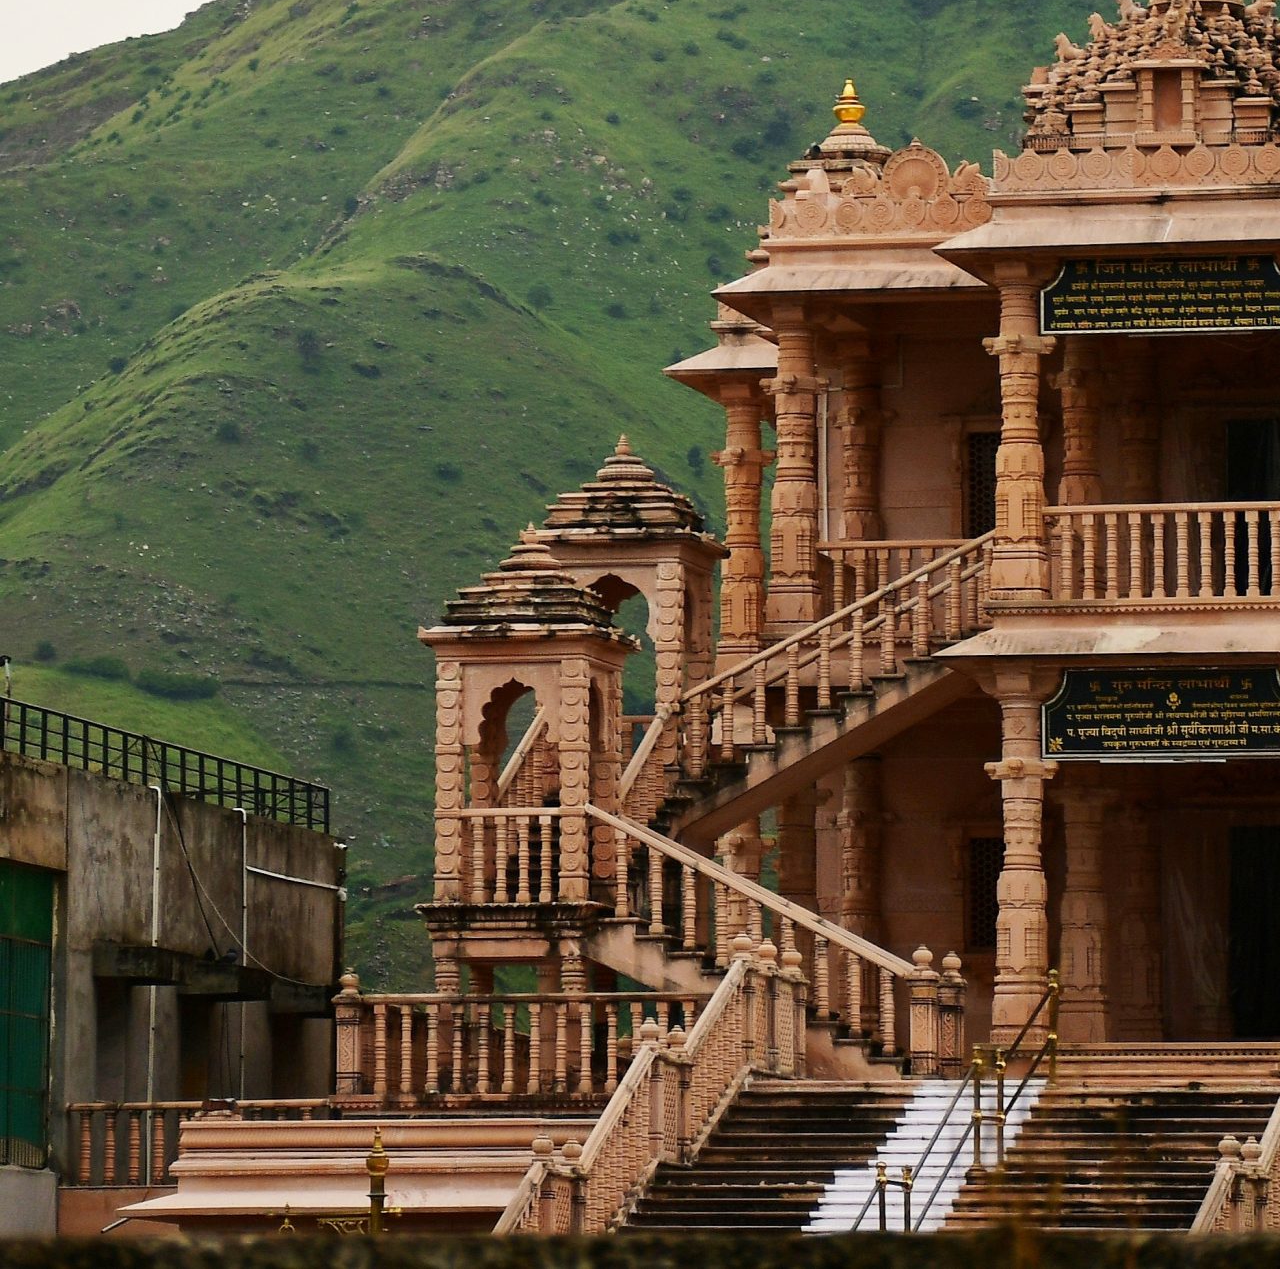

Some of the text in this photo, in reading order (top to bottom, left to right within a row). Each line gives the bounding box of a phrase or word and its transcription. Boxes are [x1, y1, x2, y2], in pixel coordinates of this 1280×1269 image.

[1096, 260, 1126, 275] जिन
[1130, 259, 1174, 276] मन्दिर
[1111, 680, 1133, 694] गुरु
[1135, 677, 1174, 691] मन्दिर
[1078, 728, 1100, 740] पूज्या
[1101, 724, 1127, 740] विदुषी
[1129, 724, 1165, 736] साध्वीजी
[1167, 721, 1179, 736] श्री
[1180, 720, 1236, 739] सूर्यकिरणाश्री
[1237, 720, 1250, 735] जी
[1198, 738, 1211, 748] एवं
